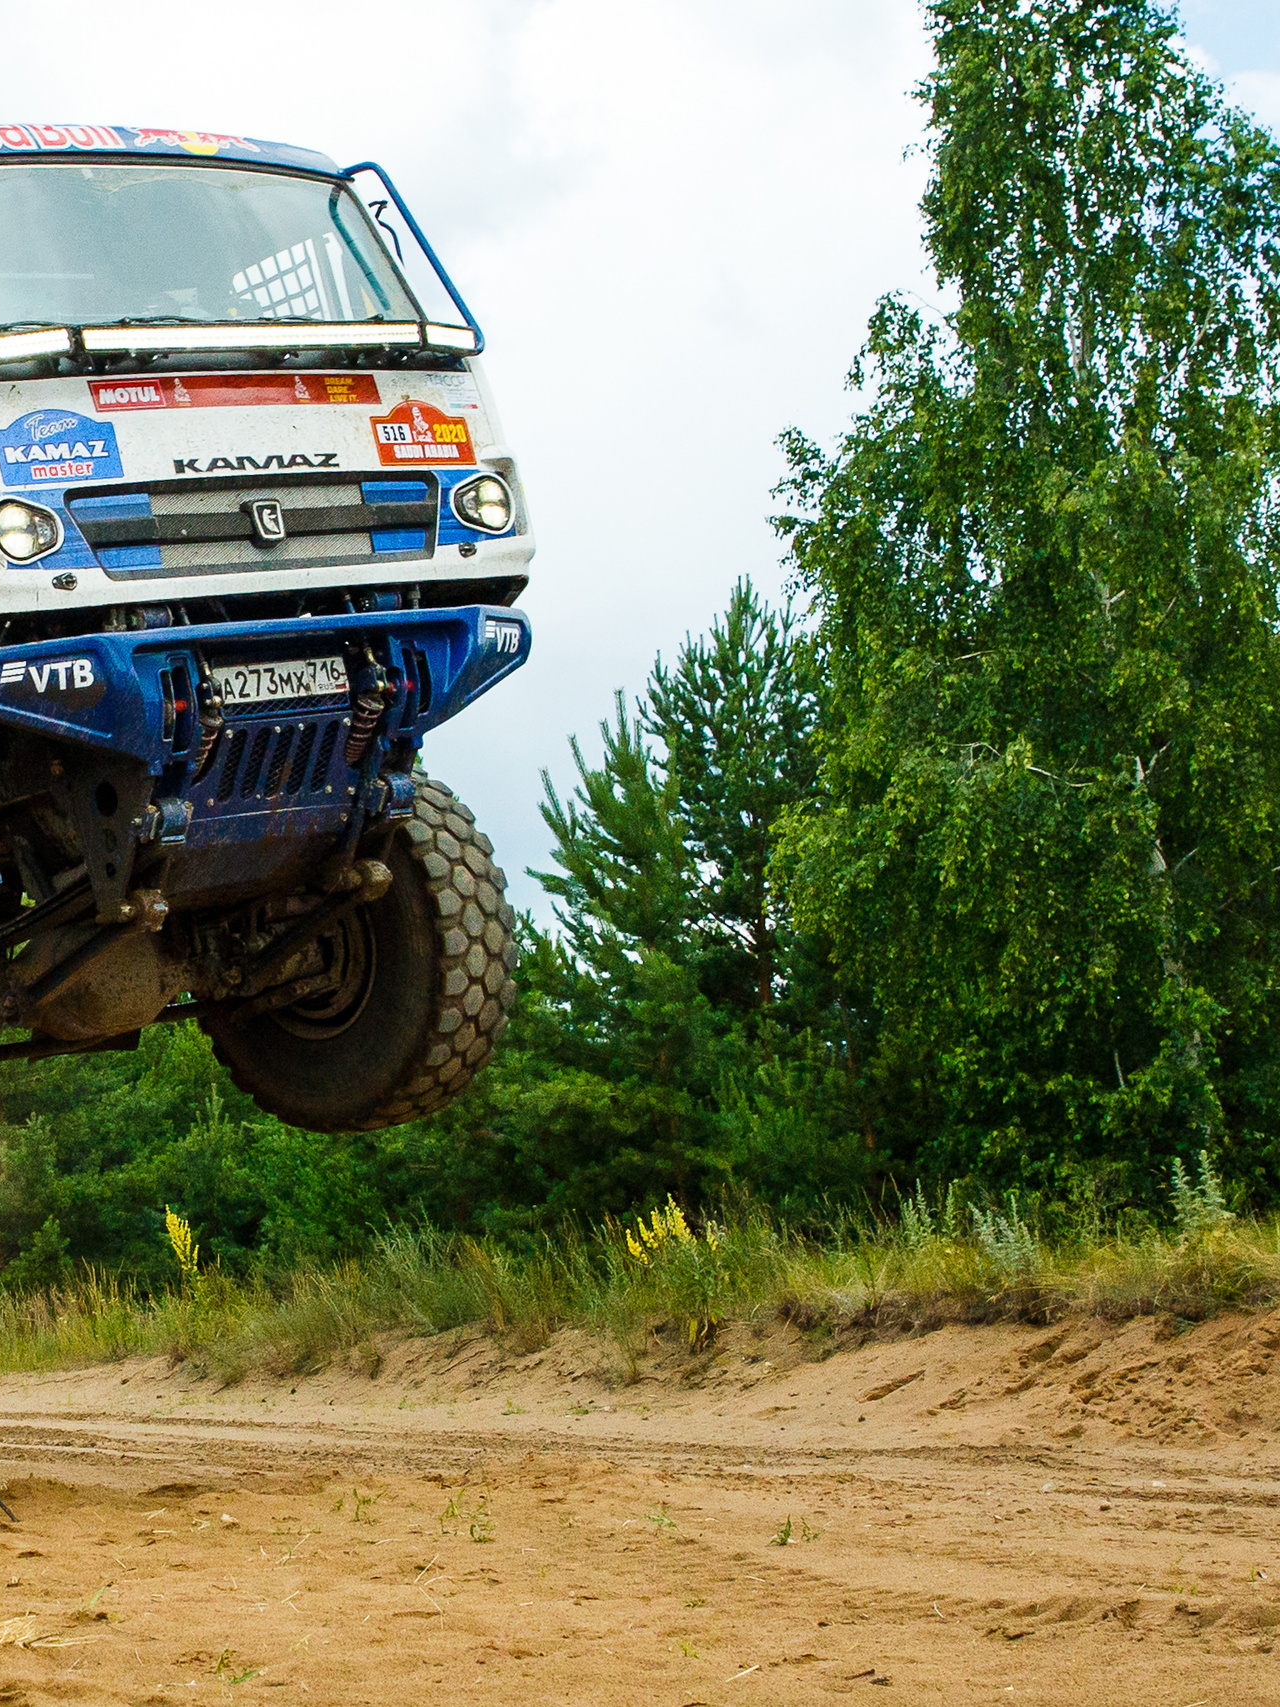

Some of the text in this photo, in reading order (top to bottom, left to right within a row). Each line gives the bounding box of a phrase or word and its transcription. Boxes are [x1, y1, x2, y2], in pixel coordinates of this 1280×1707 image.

[99, 386, 160, 405] MOTUL
[24, 414, 78, 442] Team
[382, 423, 468, 443] 516 2020
[4, 440, 109, 465] KAMAZ
[393, 444, 424, 459] SAUDI
[32, 462, 93, 478] master
[173, 453, 340, 474] KAMAZ
[494, 626, 521, 652] VTB
[28, 659, 95, 693] VTB
